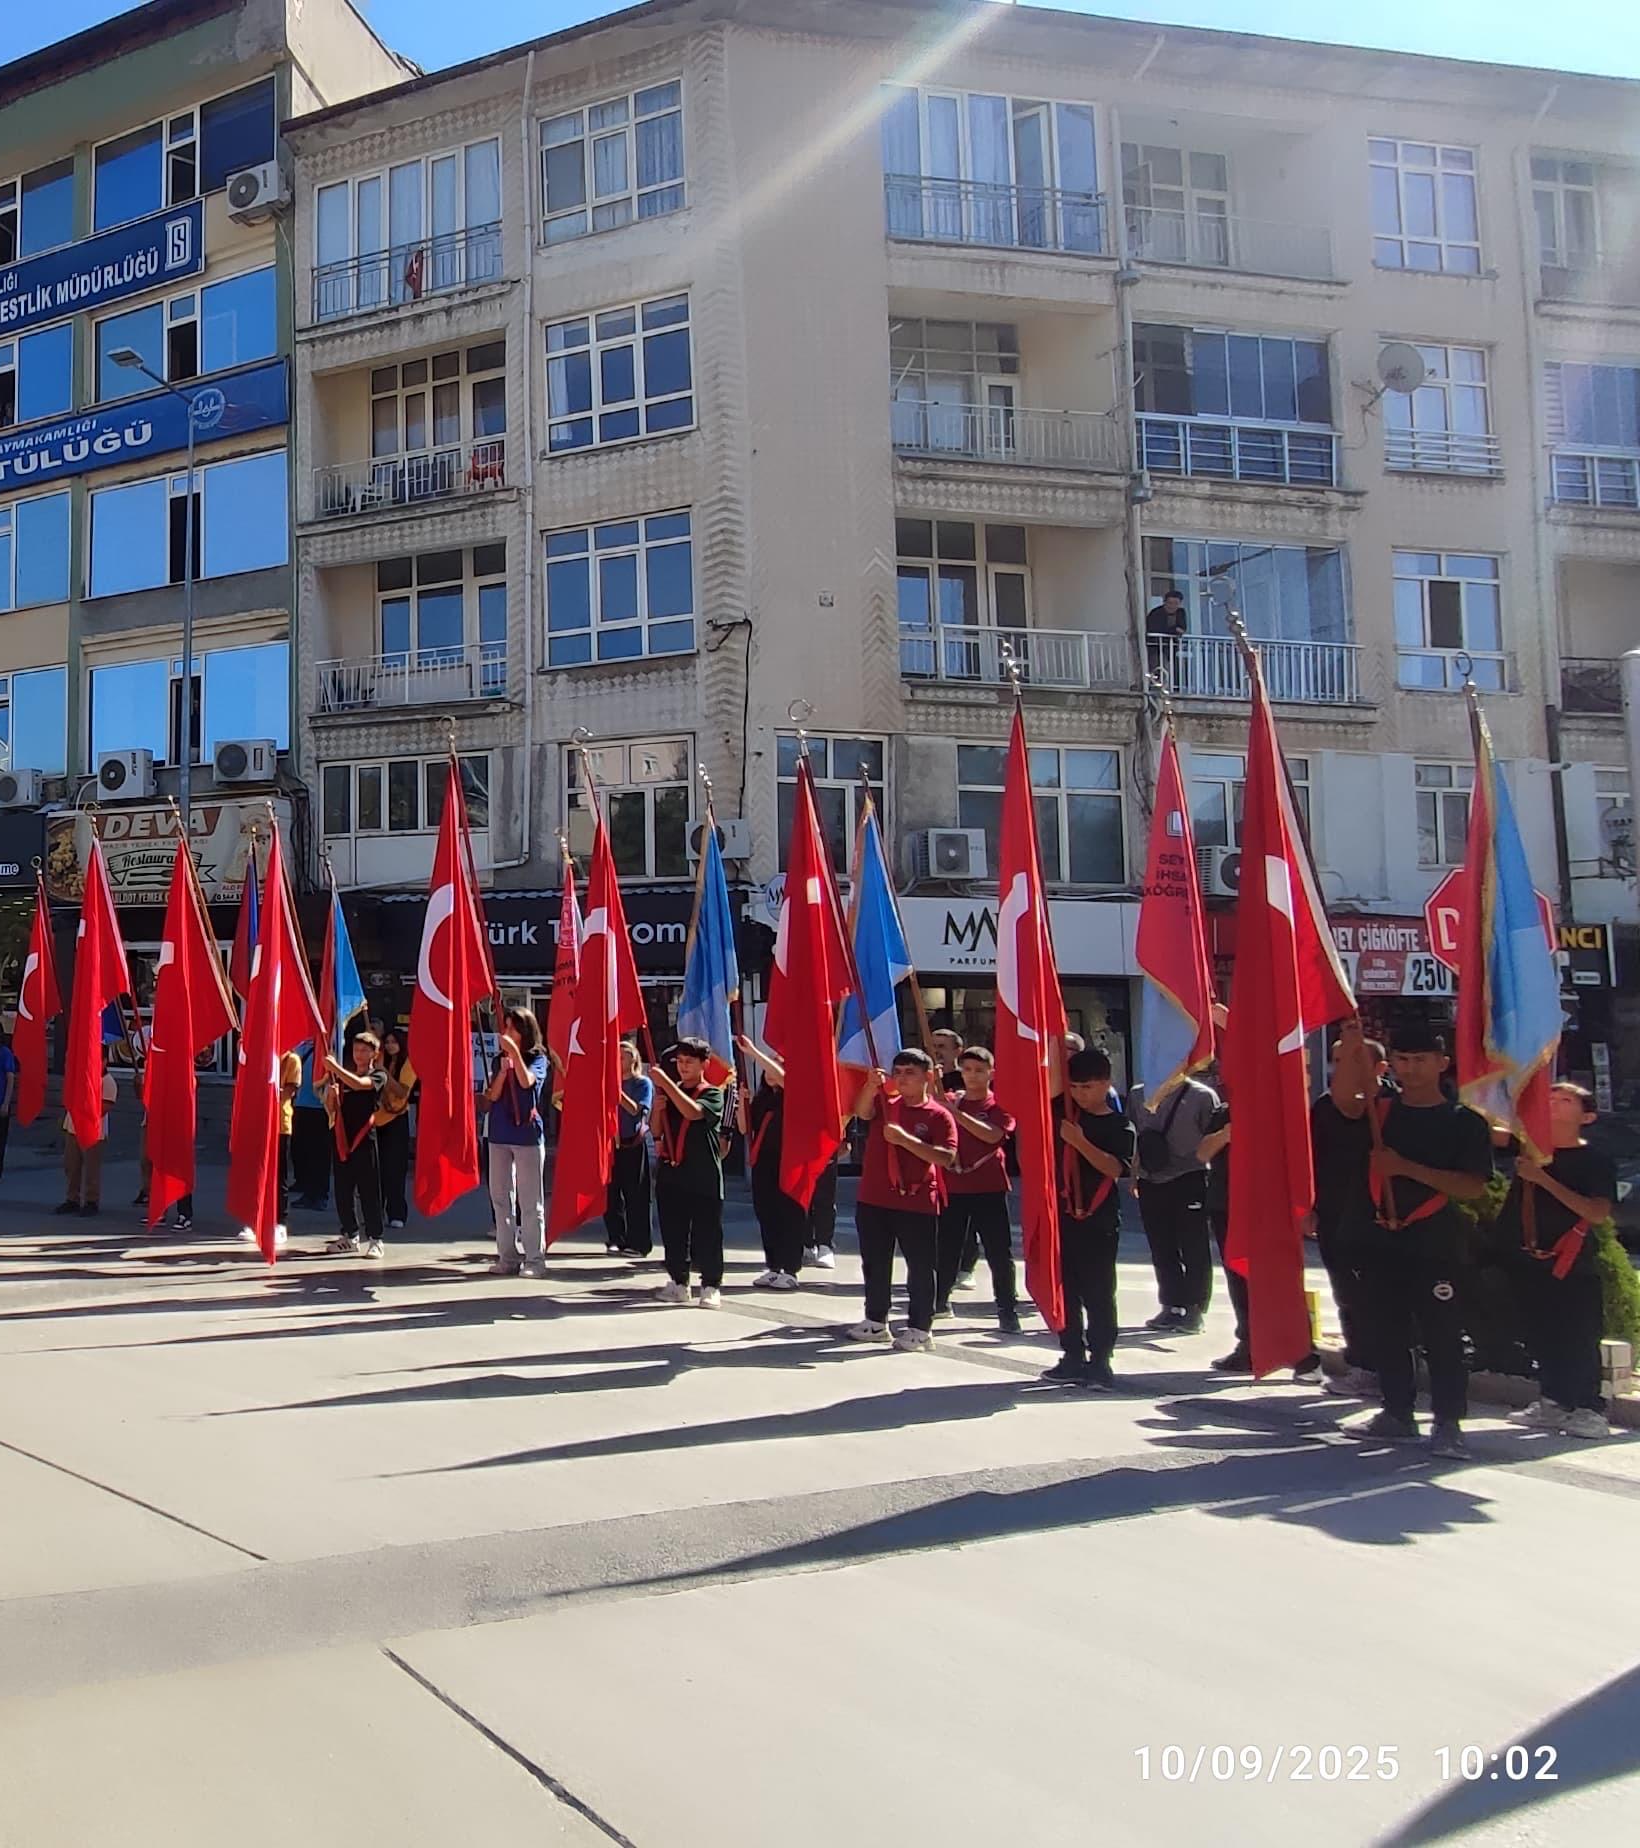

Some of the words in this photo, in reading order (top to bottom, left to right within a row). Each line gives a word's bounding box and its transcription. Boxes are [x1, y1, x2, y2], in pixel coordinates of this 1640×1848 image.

[56, 246, 159, 306] MÜDÜRLÜĞÜ
[484, 919, 538, 945] ürk
[1412, 957, 1447, 992] 250
